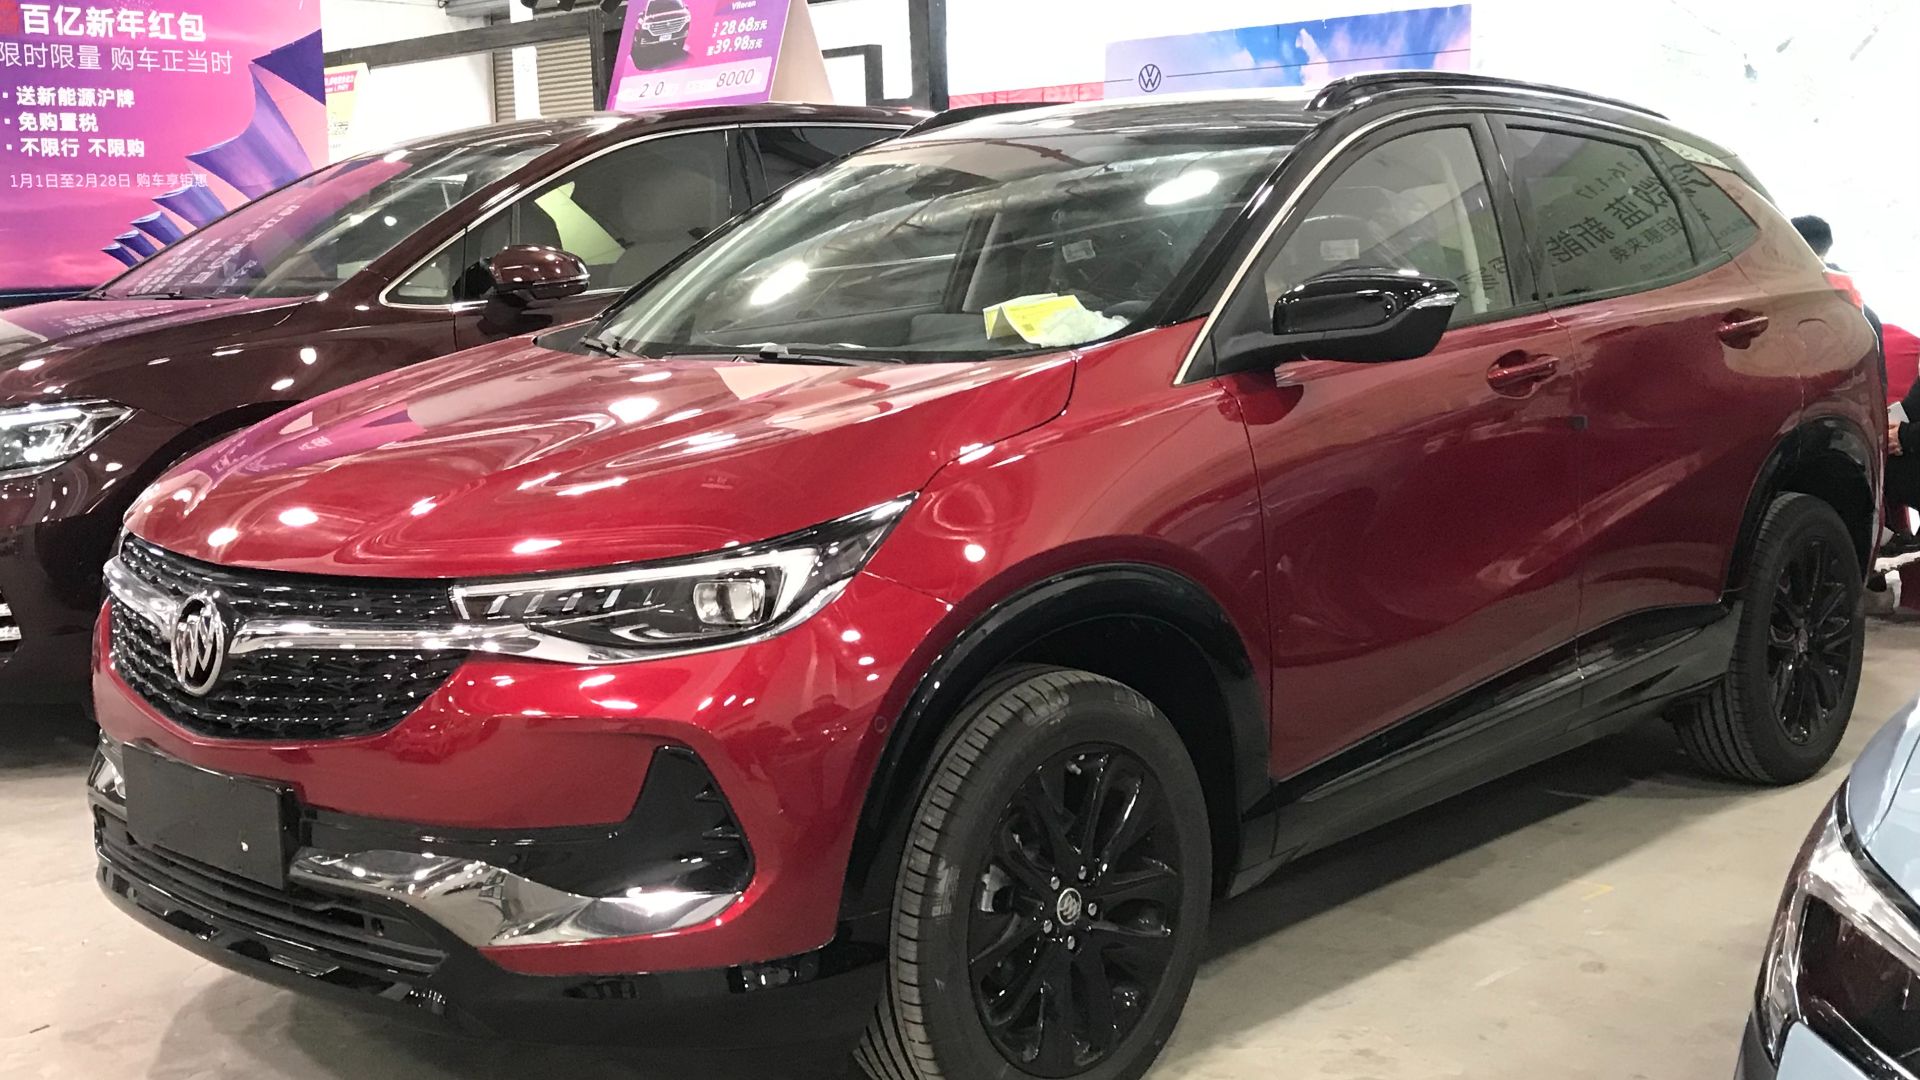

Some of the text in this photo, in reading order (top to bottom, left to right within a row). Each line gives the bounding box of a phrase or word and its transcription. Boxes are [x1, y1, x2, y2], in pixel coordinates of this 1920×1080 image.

[20, 3, 207, 42] 百亿新年红包
[0, 41, 233, 75] 限时限量 购车正当时
[716, 68, 755, 88] 8000
[16, 86, 136, 108] 送新能源沪牌
[18, 112, 99, 132] 免购置税
[20, 137, 145, 158] 不限行 不限购
[10, 173, 130, 188] 1月1日至2月28日
